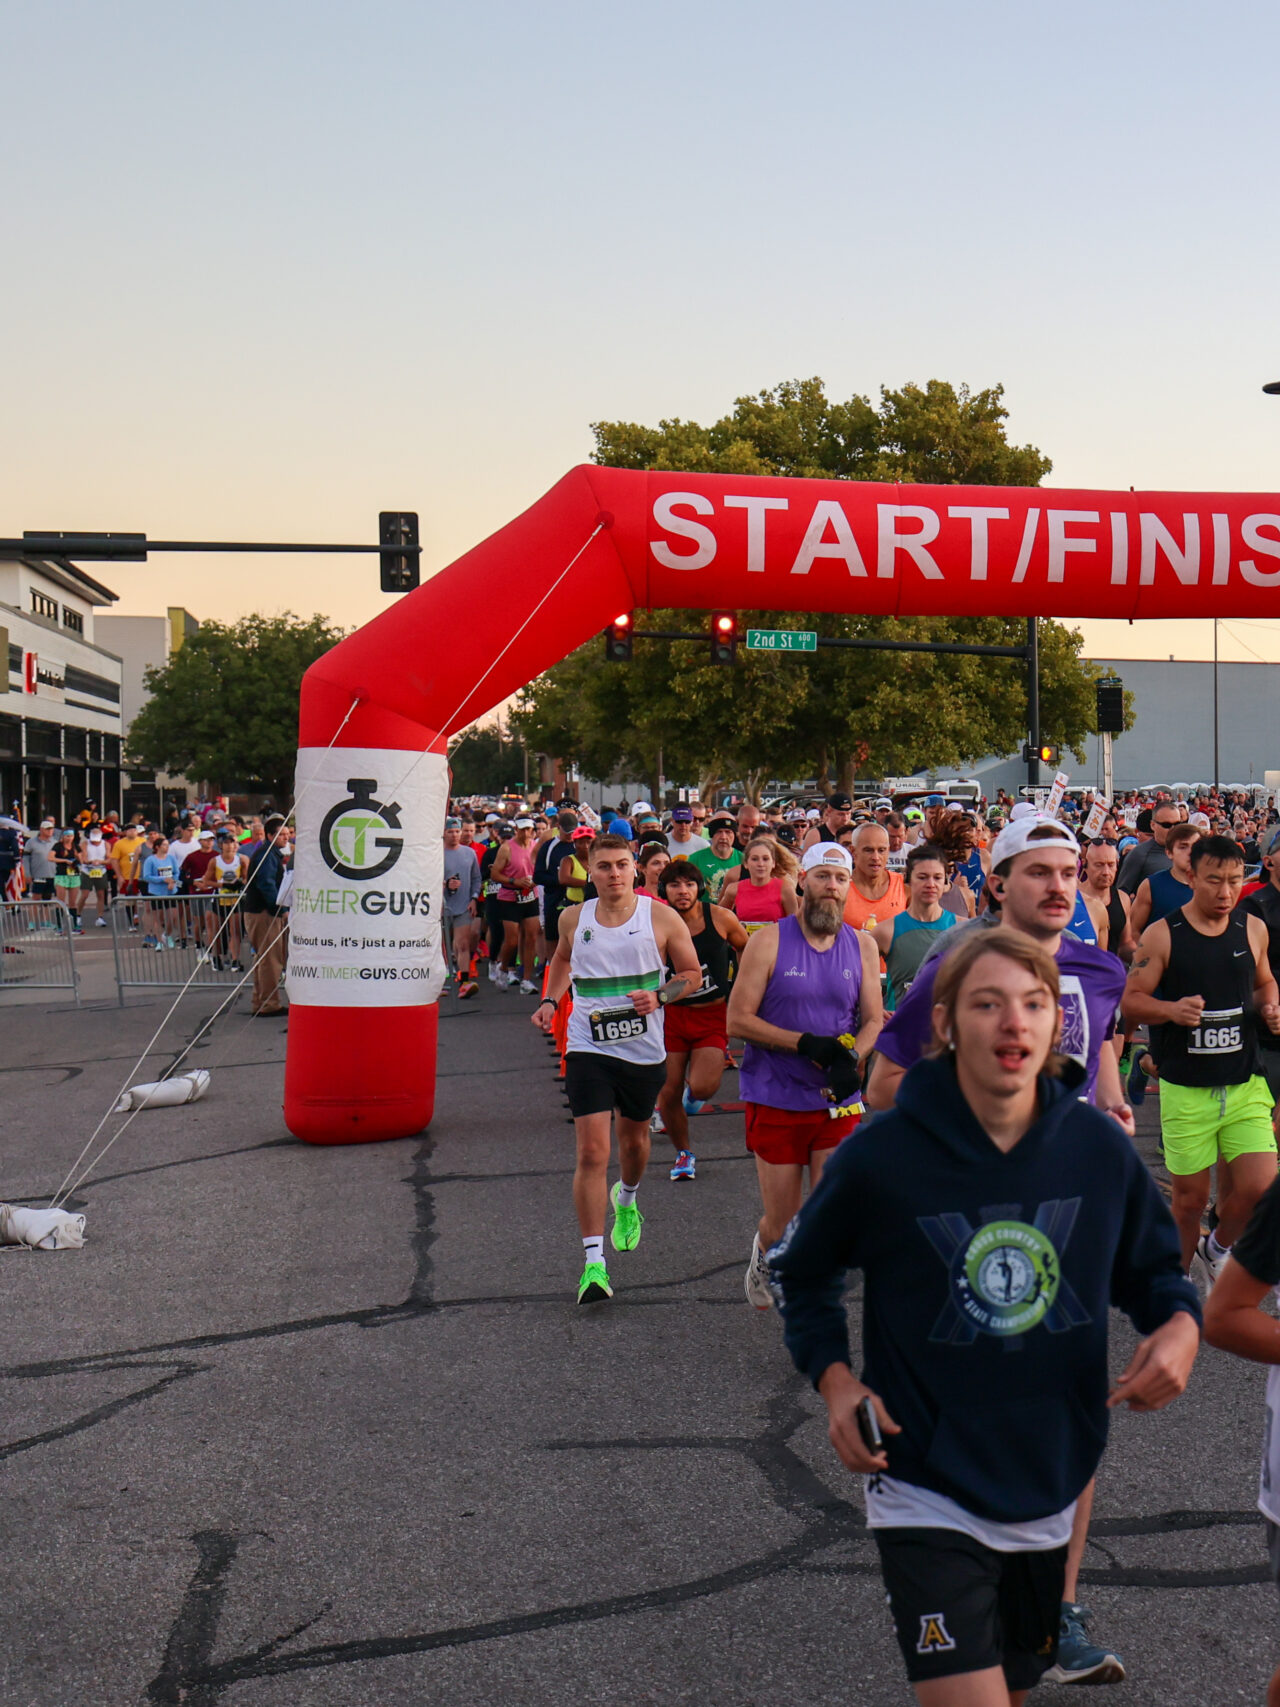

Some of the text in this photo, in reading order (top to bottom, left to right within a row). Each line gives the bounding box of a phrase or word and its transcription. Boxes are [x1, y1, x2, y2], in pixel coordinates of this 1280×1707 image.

[754, 632, 792, 648] 2nd St
[1089, 809, 1104, 831] 1:45
[296, 888, 430, 915] TIMERGUYS
[320, 938, 337, 948] us,
[341, 937, 359, 947] it's
[361, 937, 385, 949] just
[388, 940, 396, 948] a
[399, 938, 432, 949] parade.
[291, 966, 430, 979] WWW.TIMERGUYS.COM
[594, 1019, 644, 1041] 1695
[1191, 1026, 1241, 1048] 1665
[996, 1228, 1041, 1251] COUNTRY
[964, 1299, 989, 1324] STATE
[916, 1613, 956, 1654] A
